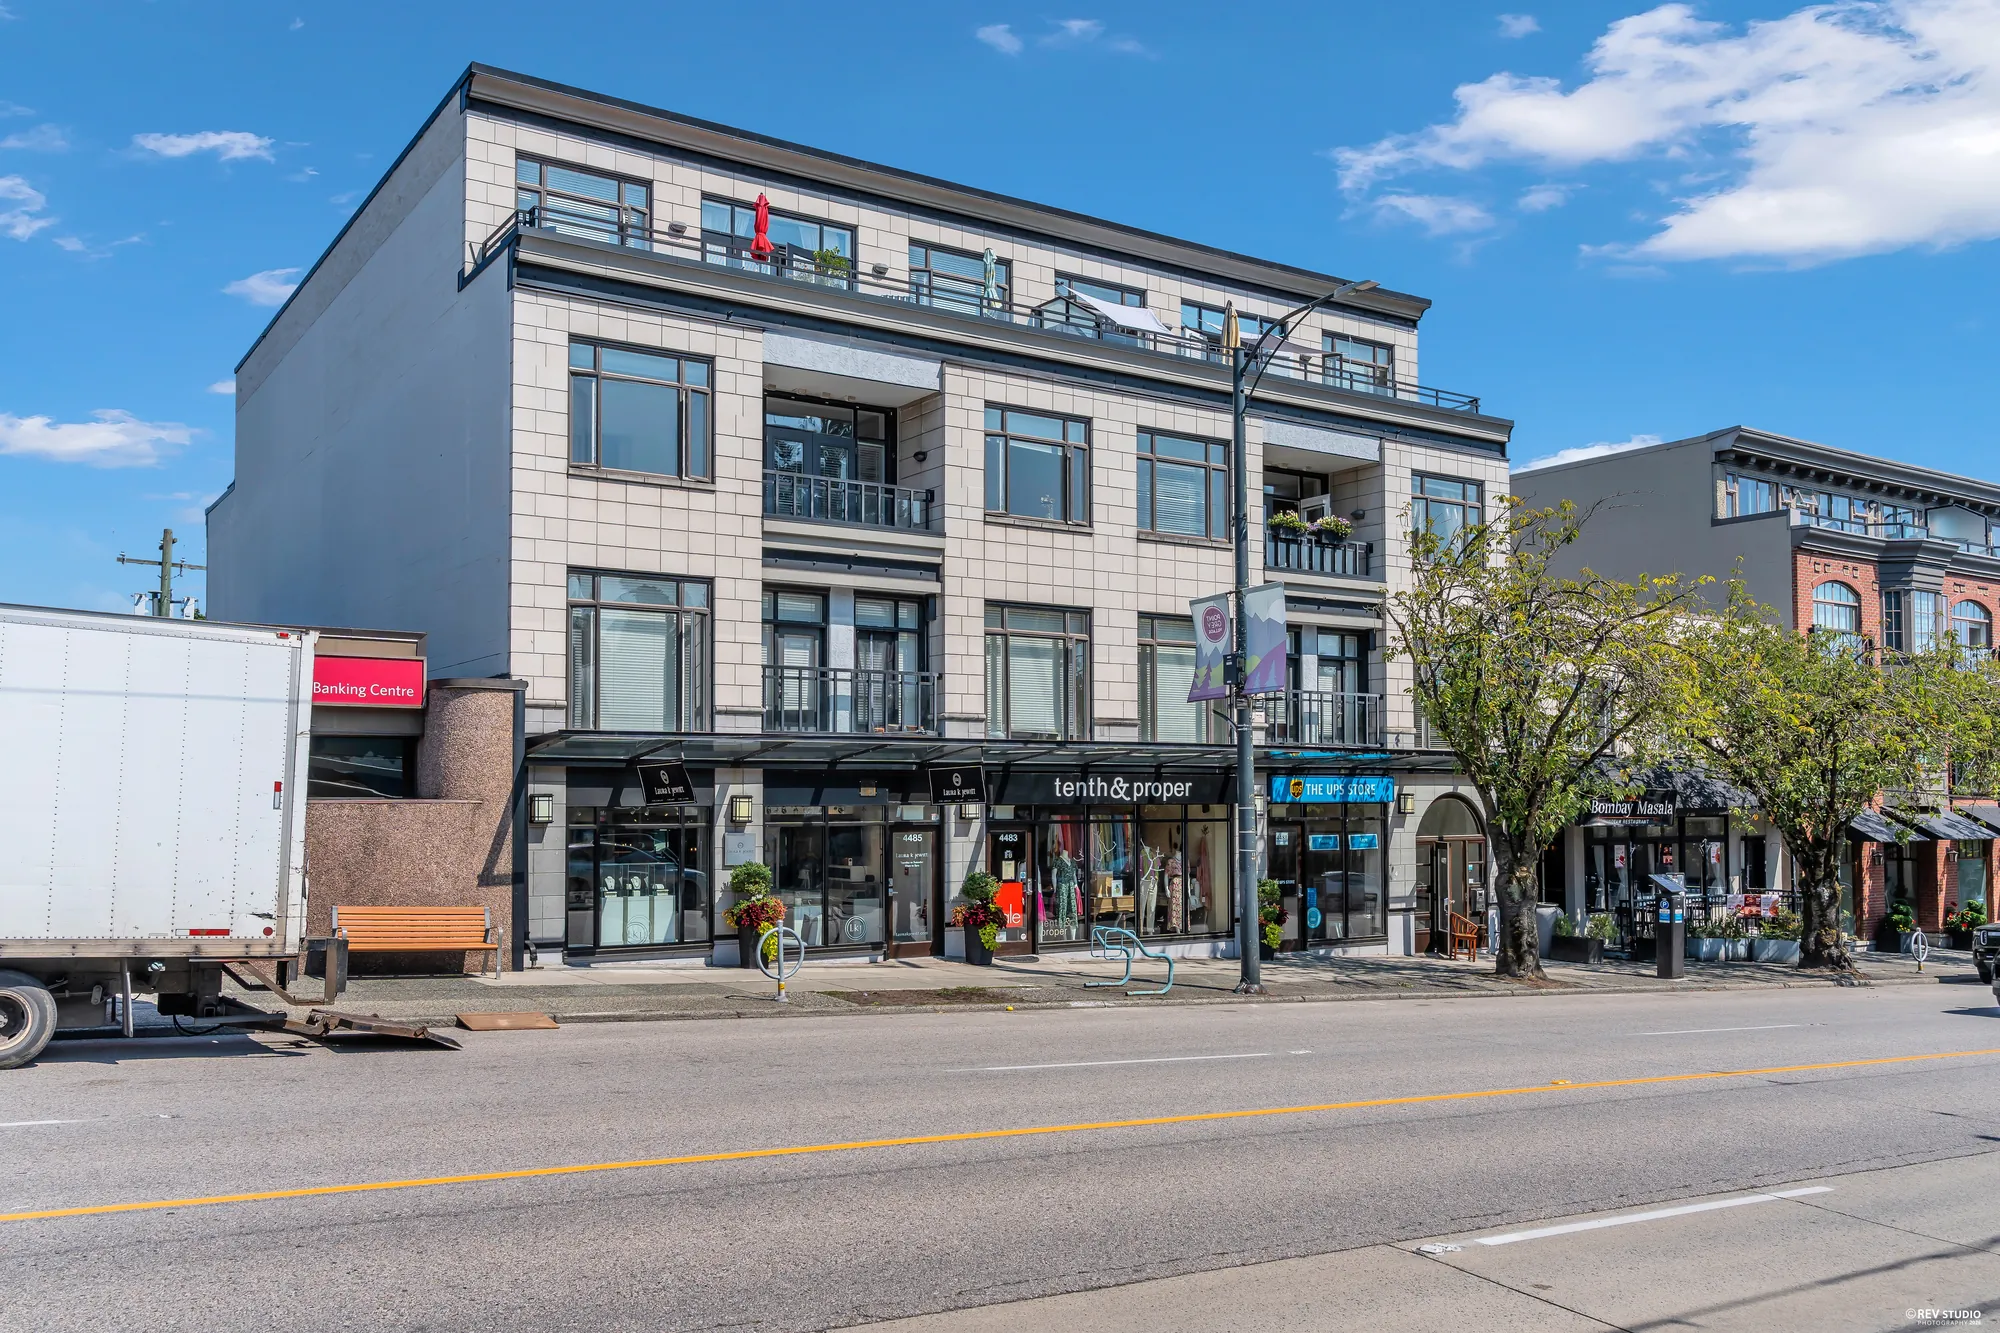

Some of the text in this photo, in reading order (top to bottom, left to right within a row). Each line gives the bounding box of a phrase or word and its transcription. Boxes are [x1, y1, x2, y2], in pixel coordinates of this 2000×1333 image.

[313, 681, 415, 698] Banking Centre
[1306, 783, 1376, 796] THE UPS STORE
[1591, 799, 1673, 818] Bombay Masala
[902, 833, 923, 842] 4485
[999, 833, 1018, 842] 4483
